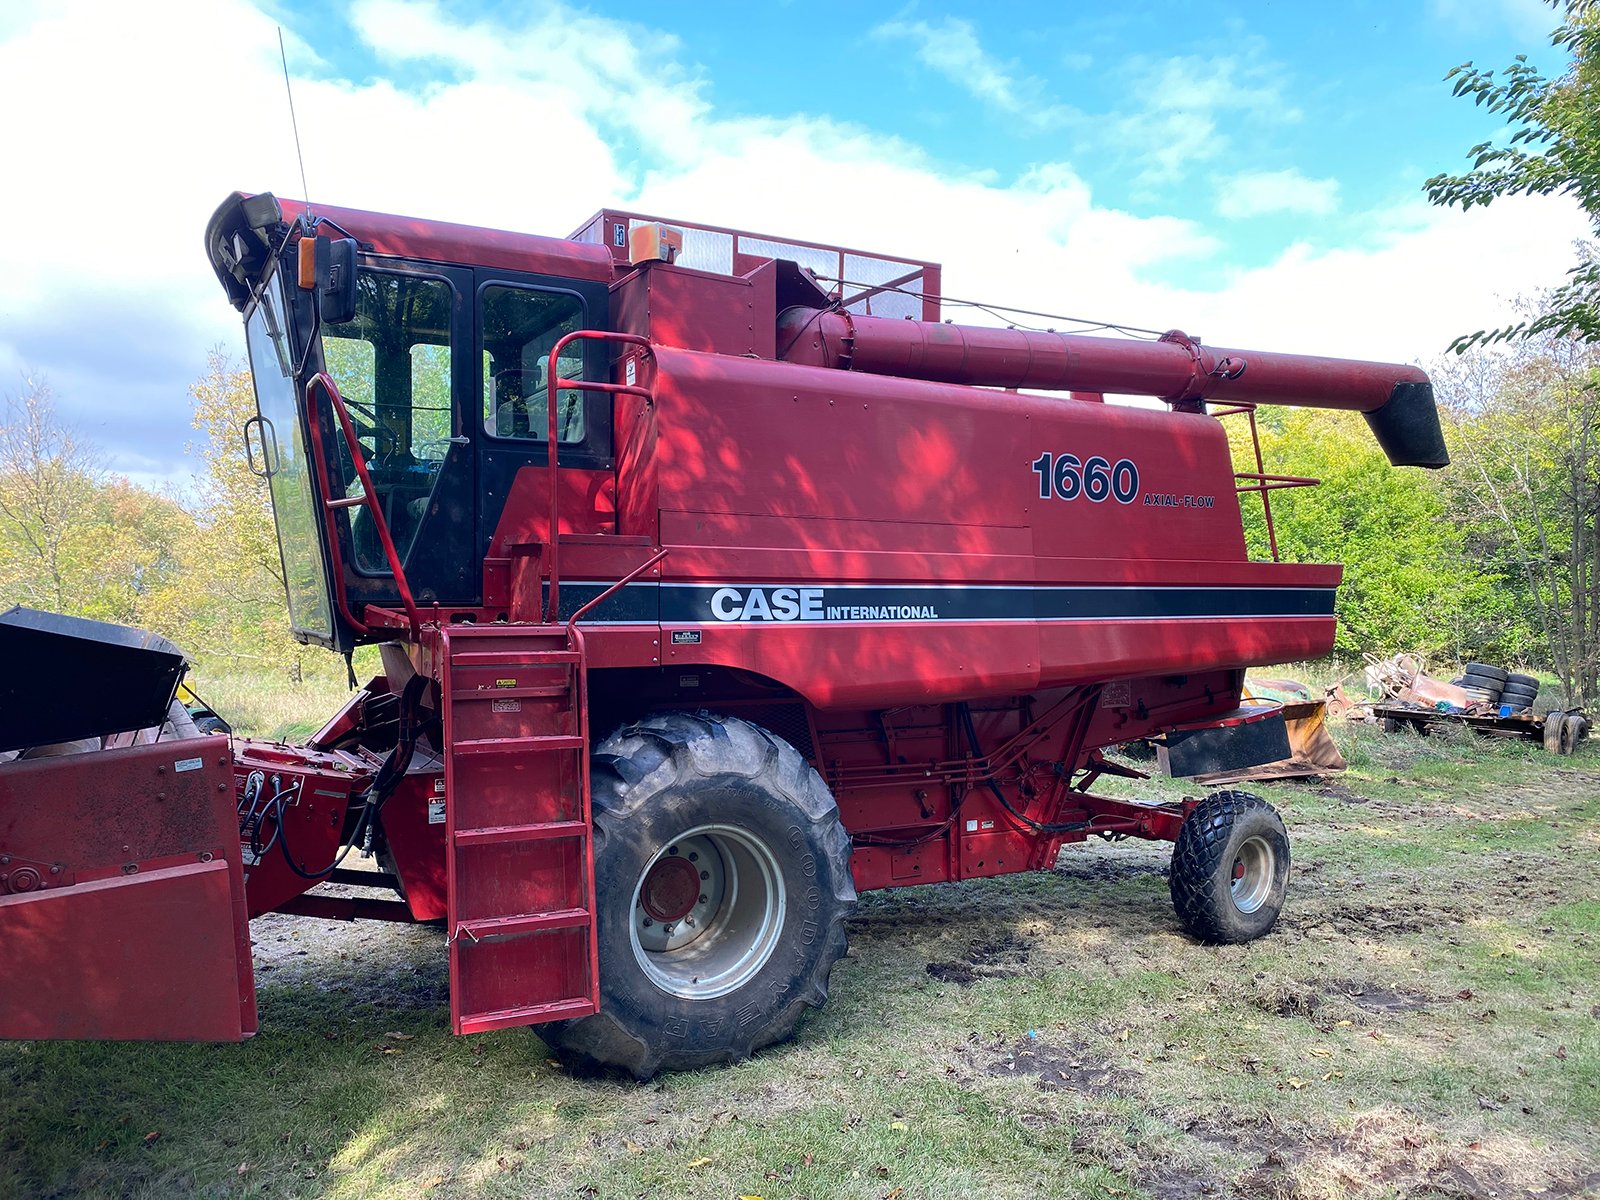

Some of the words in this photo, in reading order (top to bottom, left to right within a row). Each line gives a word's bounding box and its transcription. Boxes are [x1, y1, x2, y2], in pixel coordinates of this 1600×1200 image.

[1032, 451, 1140, 505] 1660
[1143, 493, 1215, 508] AXIAL-FLOW
[710, 588, 824, 621] CASE
[827, 605, 938, 620] INTERNATIONAL
